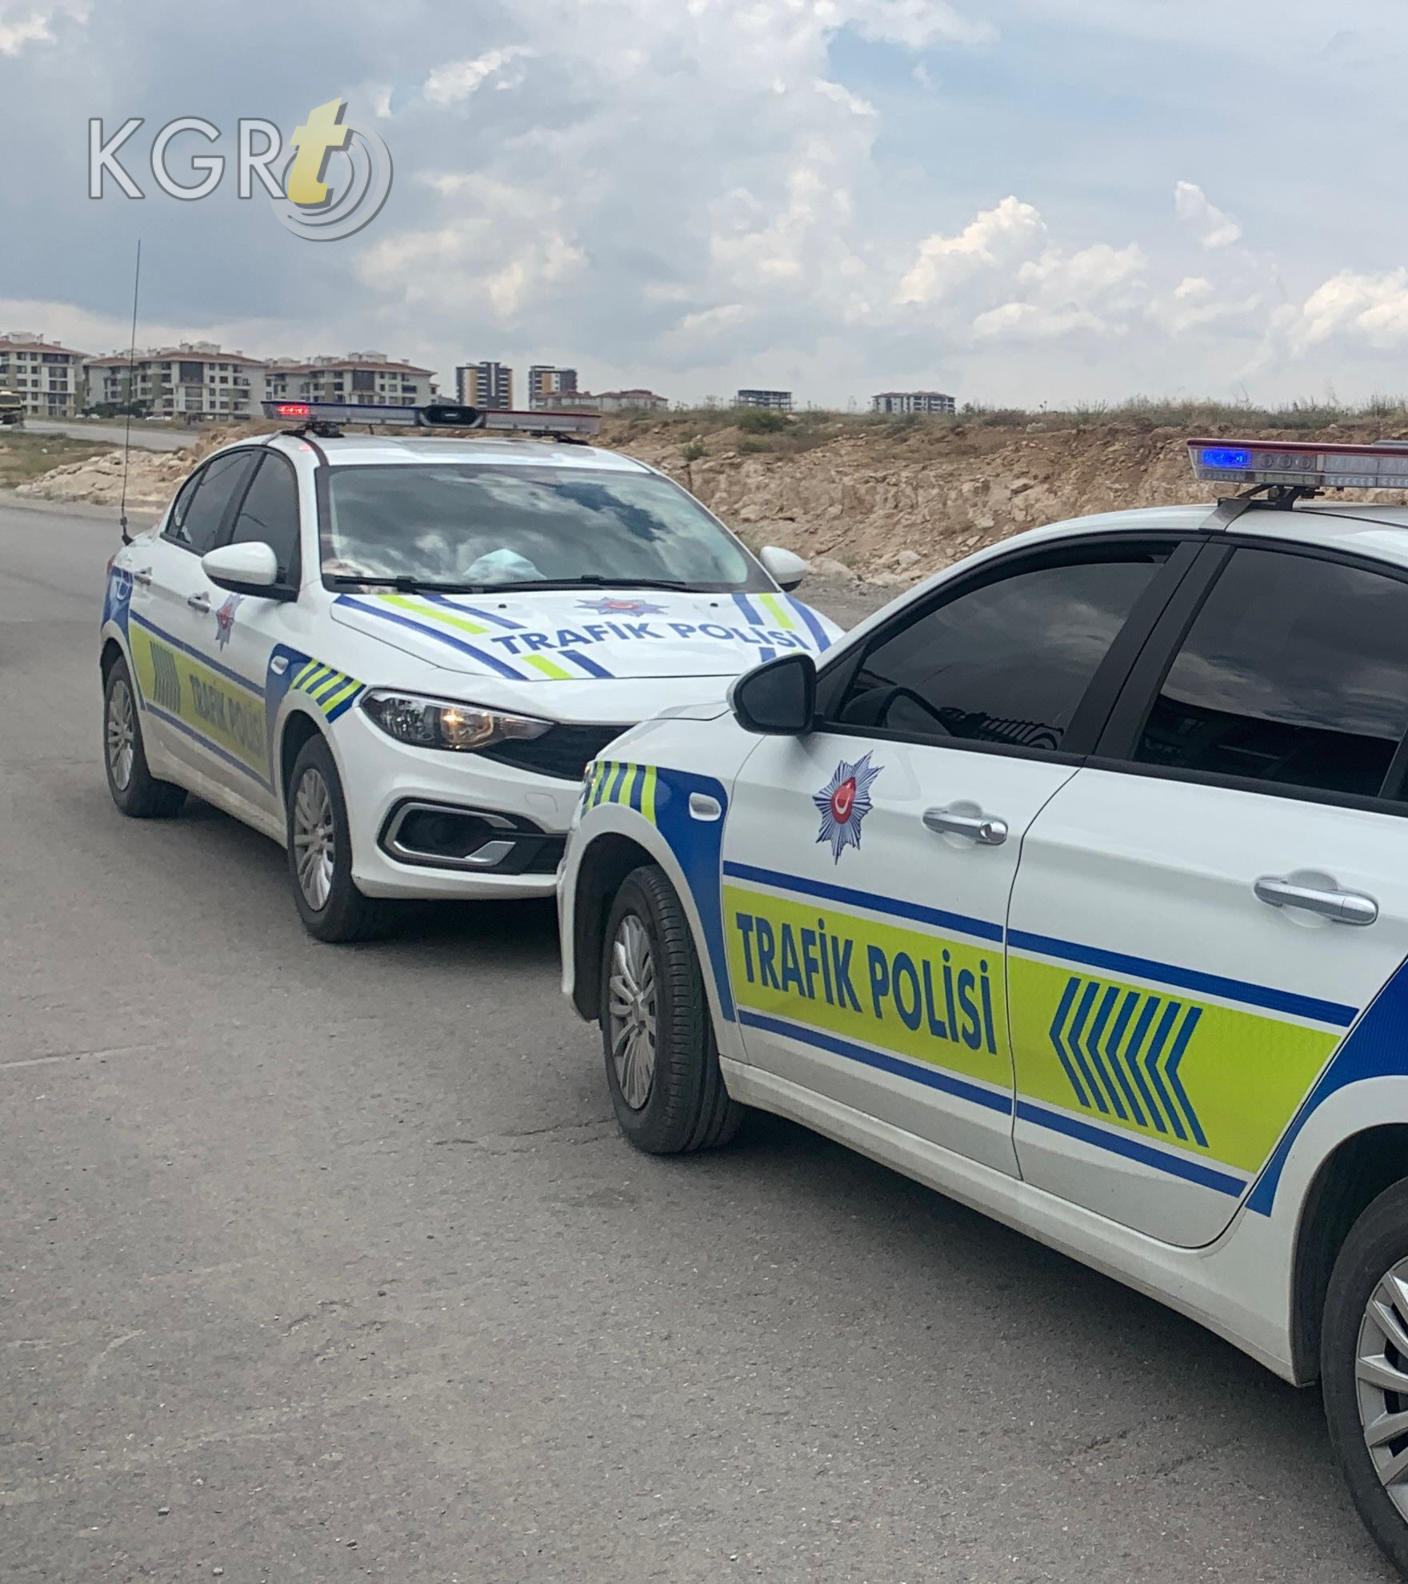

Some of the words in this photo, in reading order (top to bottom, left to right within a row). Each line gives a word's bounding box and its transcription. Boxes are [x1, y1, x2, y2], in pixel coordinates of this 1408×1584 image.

[491, 621, 664, 655] TRAFİK
[667, 622, 812, 651] POLİSİ
[735, 912, 863, 1014] TRAFİK
[866, 948, 998, 1056] POLİSİ
